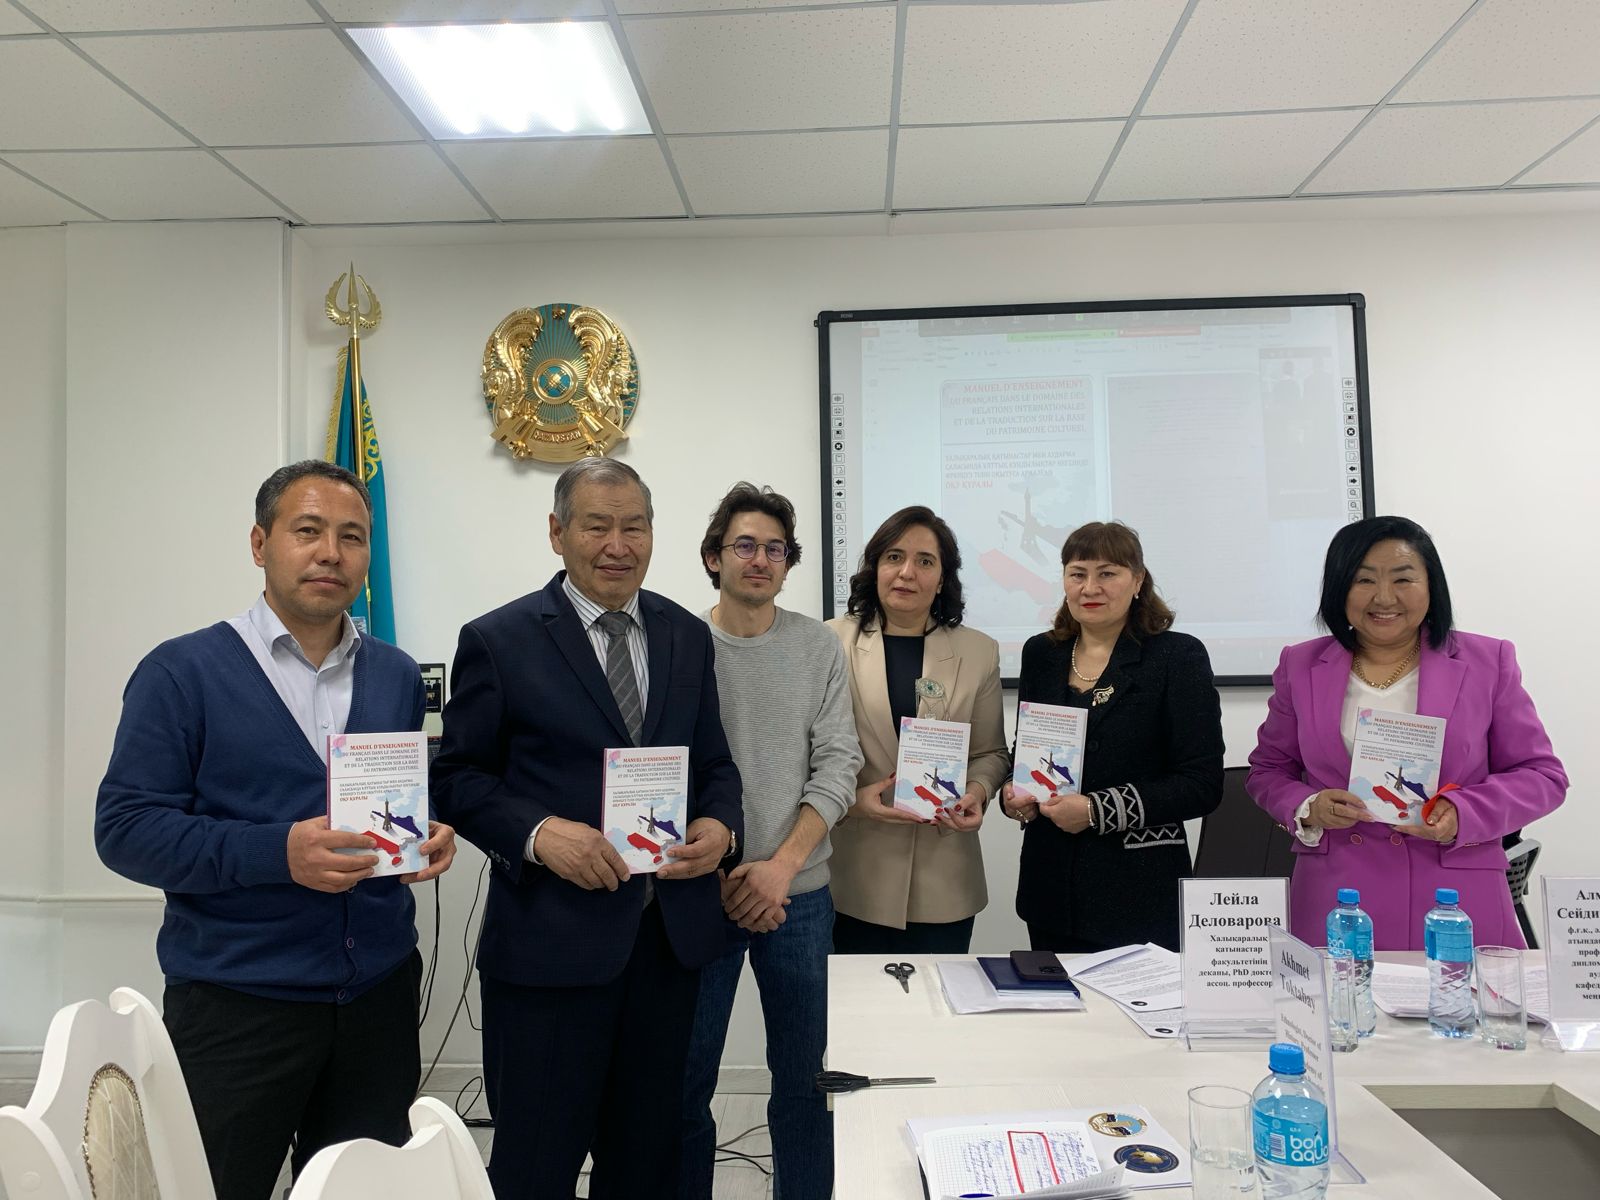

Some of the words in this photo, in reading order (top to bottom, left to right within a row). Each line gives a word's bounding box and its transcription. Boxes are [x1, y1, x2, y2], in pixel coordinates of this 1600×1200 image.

[964, 384, 1001, 393] MANUEL
[1033, 393, 1068, 401] DOMAINE
[972, 406, 1013, 415] RELATIONS
[1014, 402, 1085, 413] INTERNATIONALES
[988, 415, 1037, 424] TRADUCTION
[986, 427, 997, 435] DU
[998, 426, 1046, 435] PATRIMOINE
[1210, 893, 1259, 905] Лейла
[1557, 908, 1600, 920] Сейди
[1189, 914, 1281, 930] Деловарова
[1281, 949, 1310, 981] Akhmet
[1232, 979, 1273, 988] профессор
[1290, 1135, 1323, 1150] bon
[1291, 1146, 1328, 1164] aqua
